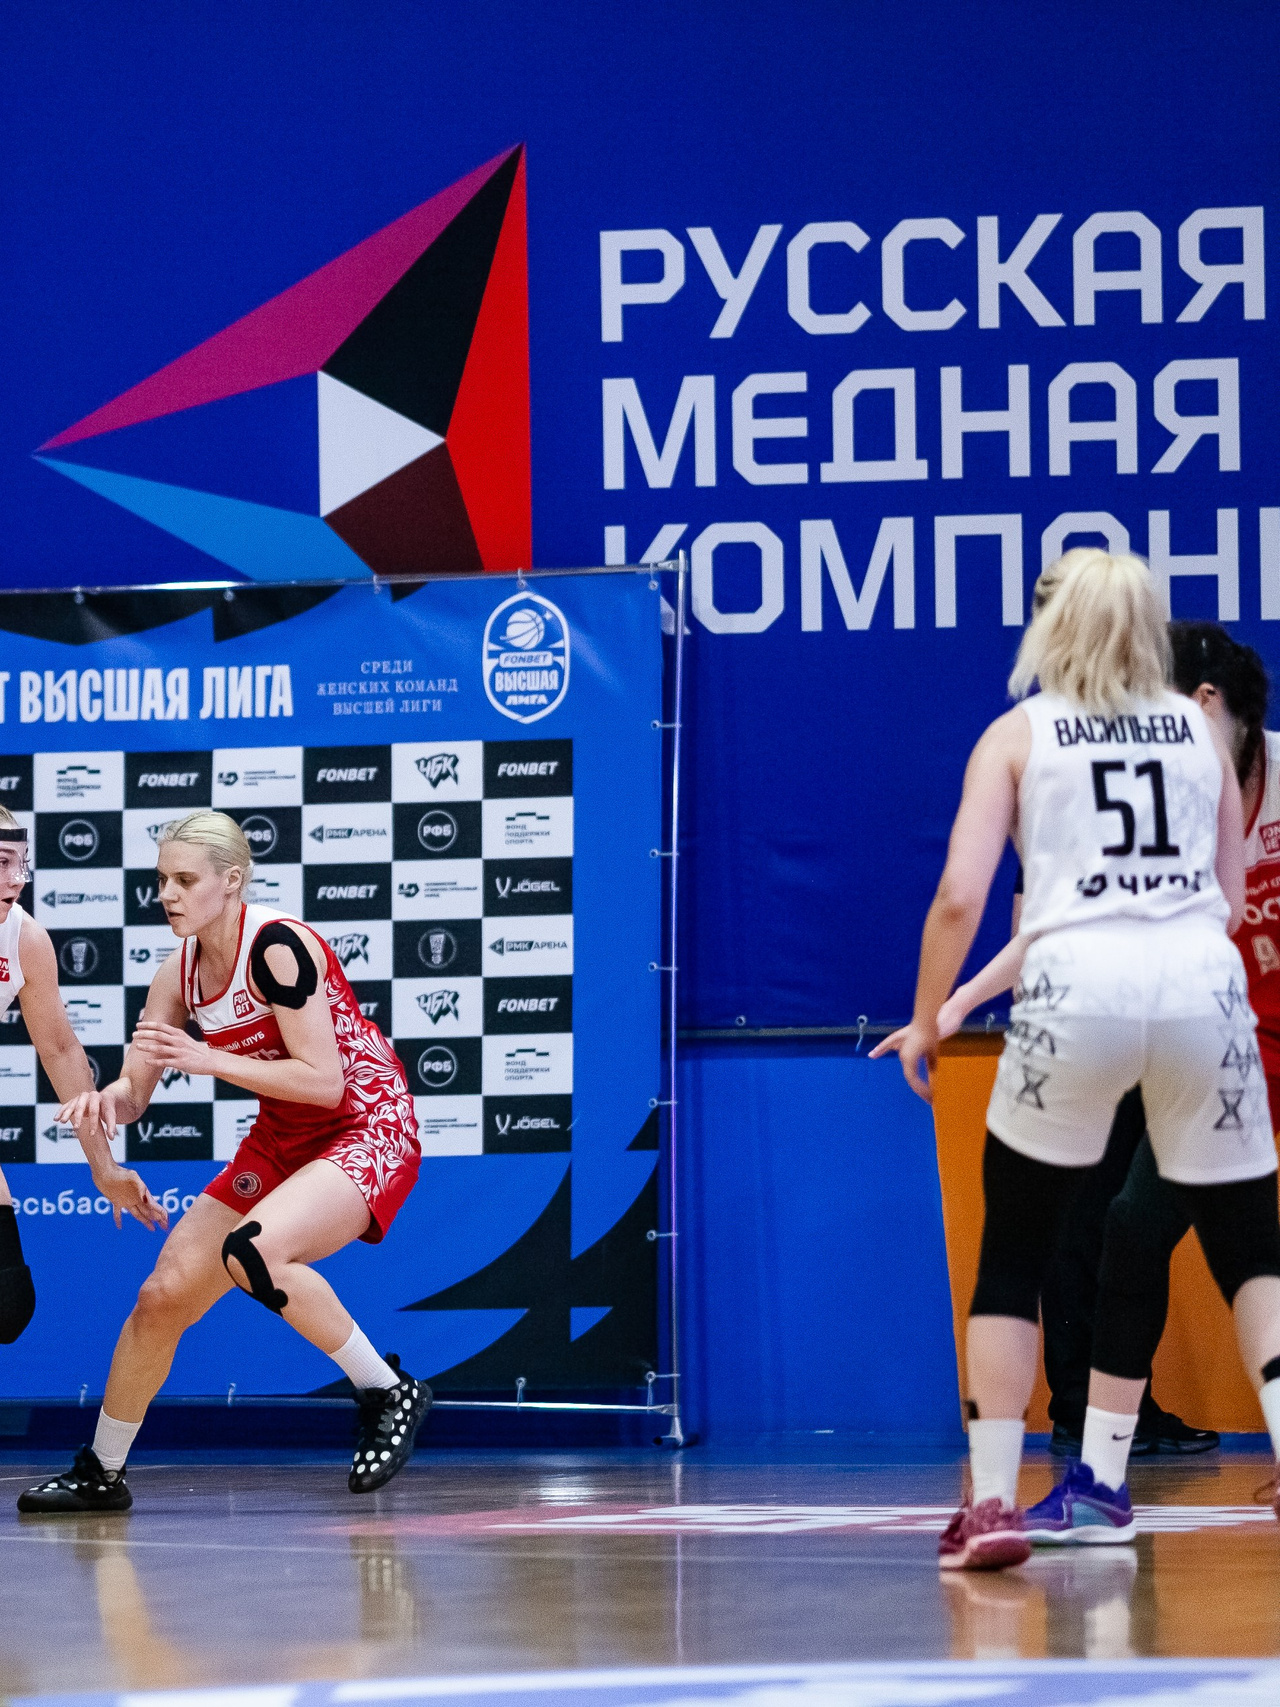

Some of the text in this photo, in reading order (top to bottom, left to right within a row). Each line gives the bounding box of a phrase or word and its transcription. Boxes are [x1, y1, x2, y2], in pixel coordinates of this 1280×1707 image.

[600, 205, 1266, 343] РУССКАЯ
[602, 357, 1241, 491] МЕДНАЯ
[360, 660, 414, 674] СРЕДИ
[503, 654, 548, 665] FONBET
[317, 678, 459, 696] ЖЕНСКИХ КОМАНД
[495, 670, 559, 692] ВЫСШАЯ
[19, 668, 190, 724] ВЫСШАЯ
[200, 664, 294, 720] ЛИГА
[332, 699, 443, 715] ВЫСШЕЙ ЛИГИ
[1054, 713, 1195, 747] ВАСИЛЬЕВА
[317, 767, 378, 782] FONBET
[497, 761, 559, 776] FONBET
[138, 773, 199, 788] FONBET
[1090, 760, 1181, 858] 51
[352, 828, 387, 838] АРЕНА
[422, 824, 452, 837] РФБ
[64, 833, 94, 847] РФБ
[317, 884, 378, 899] FONBET
[511, 878, 561, 893] JÖGEL
[532, 940, 568, 950] АРЕНА
[233, 991, 247, 1006] FON
[497, 998, 559, 1013] FONBET
[235, 1001, 251, 1016] BET
[241, 1031, 266, 1048] КЛУБ
[423, 1060, 452, 1073] РФБ
[511, 1115, 560, 1130] JÖGEL
